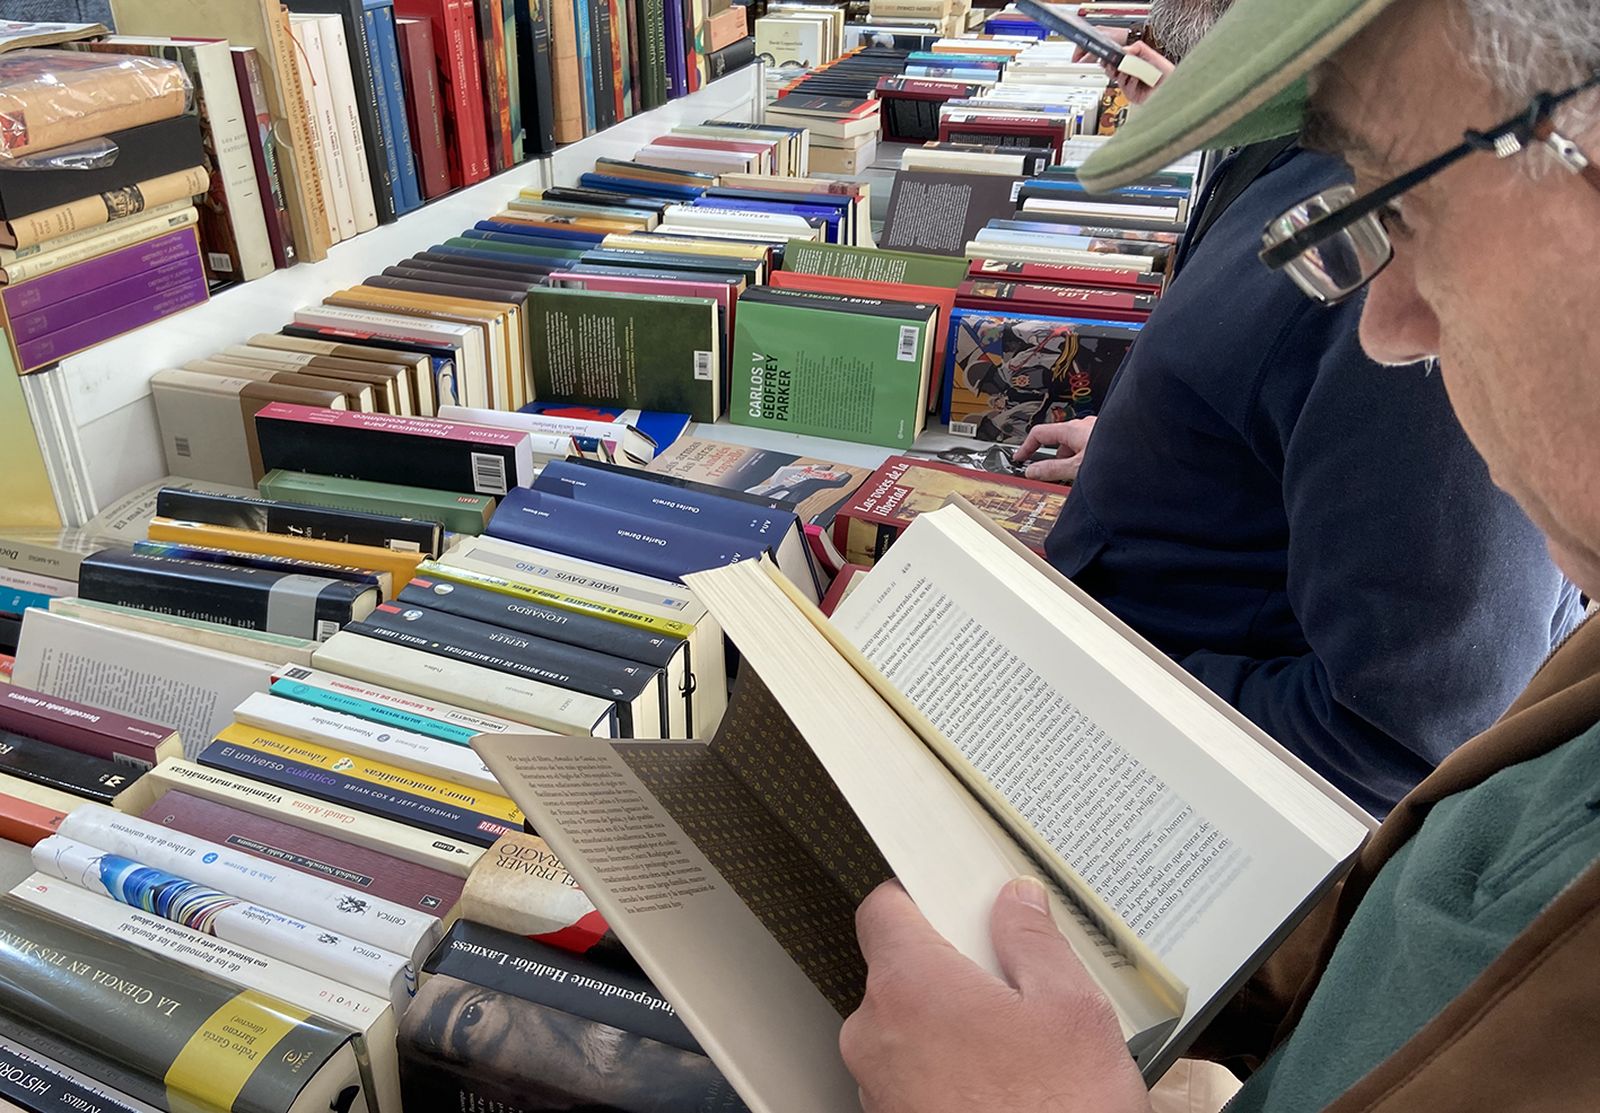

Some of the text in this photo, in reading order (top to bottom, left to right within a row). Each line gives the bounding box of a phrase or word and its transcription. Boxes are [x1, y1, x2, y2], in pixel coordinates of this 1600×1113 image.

[738, 211, 770, 219] HITLER
[849, 297, 880, 305] CARLOS
[749, 352, 765, 418] CARLOS V
[762, 354, 778, 420] GEOFFREY
[776, 370, 791, 421] PARKER
[352, 413, 407, 424] económico
[409, 419, 440, 429] análisis
[387, 423, 448, 436] Matemáticas
[469, 430, 509, 439] PEARSON
[657, 438, 703, 476] Las armas
[855, 459, 909, 514] Las voces de la
[651, 497, 699, 513] Charles Darwin
[872, 484, 910, 519] libertad
[616, 528, 667, 546] Charles Darwin
[514, 561, 535, 573] RÍO
[554, 571, 620, 593] WADE DAVIS
[505, 603, 568, 624] LEONARDO
[373, 626, 399, 638] LAUNAY
[487, 633, 529, 649] KEPLER
[443, 644, 569, 681] LA GRAN NOVELA DE LAS MATEMÁTICAS
[7, 691, 100, 724] Descodificando el universo
[251, 735, 327, 764] Edward Frenkel
[220, 745, 337, 786] El universo cuántico
[169, 764, 281, 804] Vitaminas matemáticas
[361, 766, 475, 806] Amor y matemáticas
[343, 782, 461, 821] BRIAN COX & JEFF FORSHAW
[290, 799, 355, 825] Claudi Alsina
[109, 821, 195, 856] El libro de los universos
[498, 840, 567, 871] RAGIO
[222, 859, 248, 873] Barrow
[495, 853, 577, 887] EL PRIMER
[1121, 820, 1211, 918] es la peor señal en que mirar de-
[257, 870, 276, 883] John
[130, 913, 153, 927] cálculo
[151, 921, 165, 931] del
[240, 908, 270, 926] Líquidos
[287, 919, 305, 930] Mark
[376, 910, 406, 926] CRÍTICA
[164, 925, 188, 940] ciencia
[187, 934, 195, 942] la
[117, 920, 240, 973] de los Bernoulli a los Bourbaki
[199, 938, 216, 949] arte
[214, 944, 227, 955] del
[351, 945, 381, 961] CRÍTICA
[38, 946, 65, 966] TUS
[226, 949, 254, 965] historia
[253, 959, 267, 969] una
[66, 958, 90, 976] EN
[450, 938, 676, 1016] independiente Halldór Laxness
[90, 969, 153, 1007] CIENCIA
[155, 995, 180, 1018] LA
[220, 1024, 256, 1045] Barreno
[229, 1014, 267, 1035] (director)
[201, 1029, 258, 1061] Pedro García
